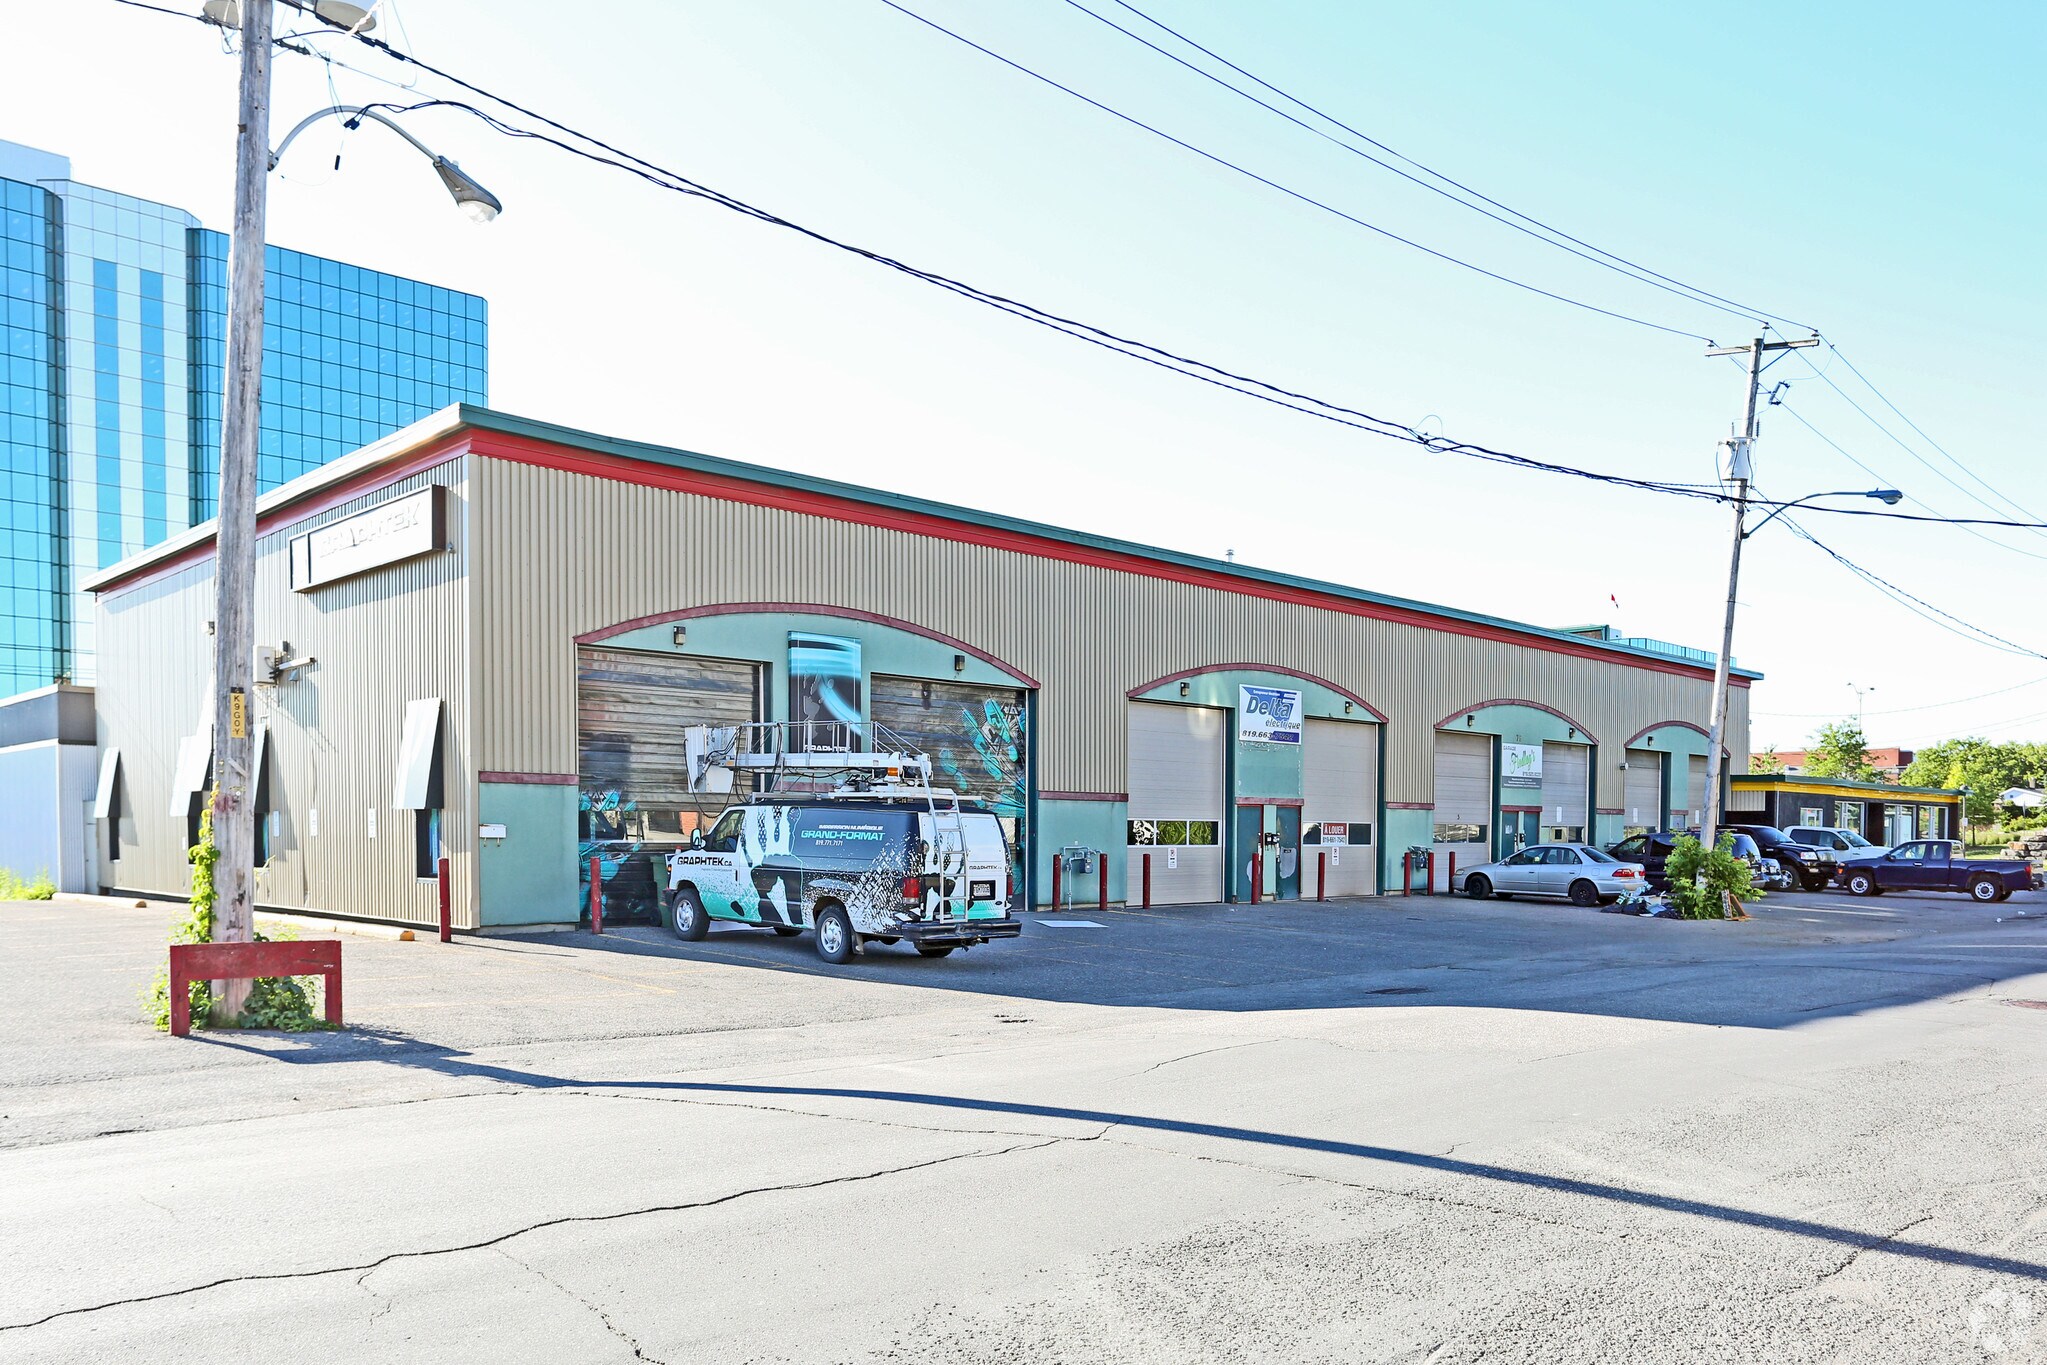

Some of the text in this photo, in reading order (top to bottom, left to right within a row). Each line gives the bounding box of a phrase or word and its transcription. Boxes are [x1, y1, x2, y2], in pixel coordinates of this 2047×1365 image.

[1246, 695, 1292, 718] Delta
[1265, 718, 1301, 730] électrique
[1329, 825, 1345, 834] LOUER
[801, 830, 886, 841] GRAND-FORMAT
